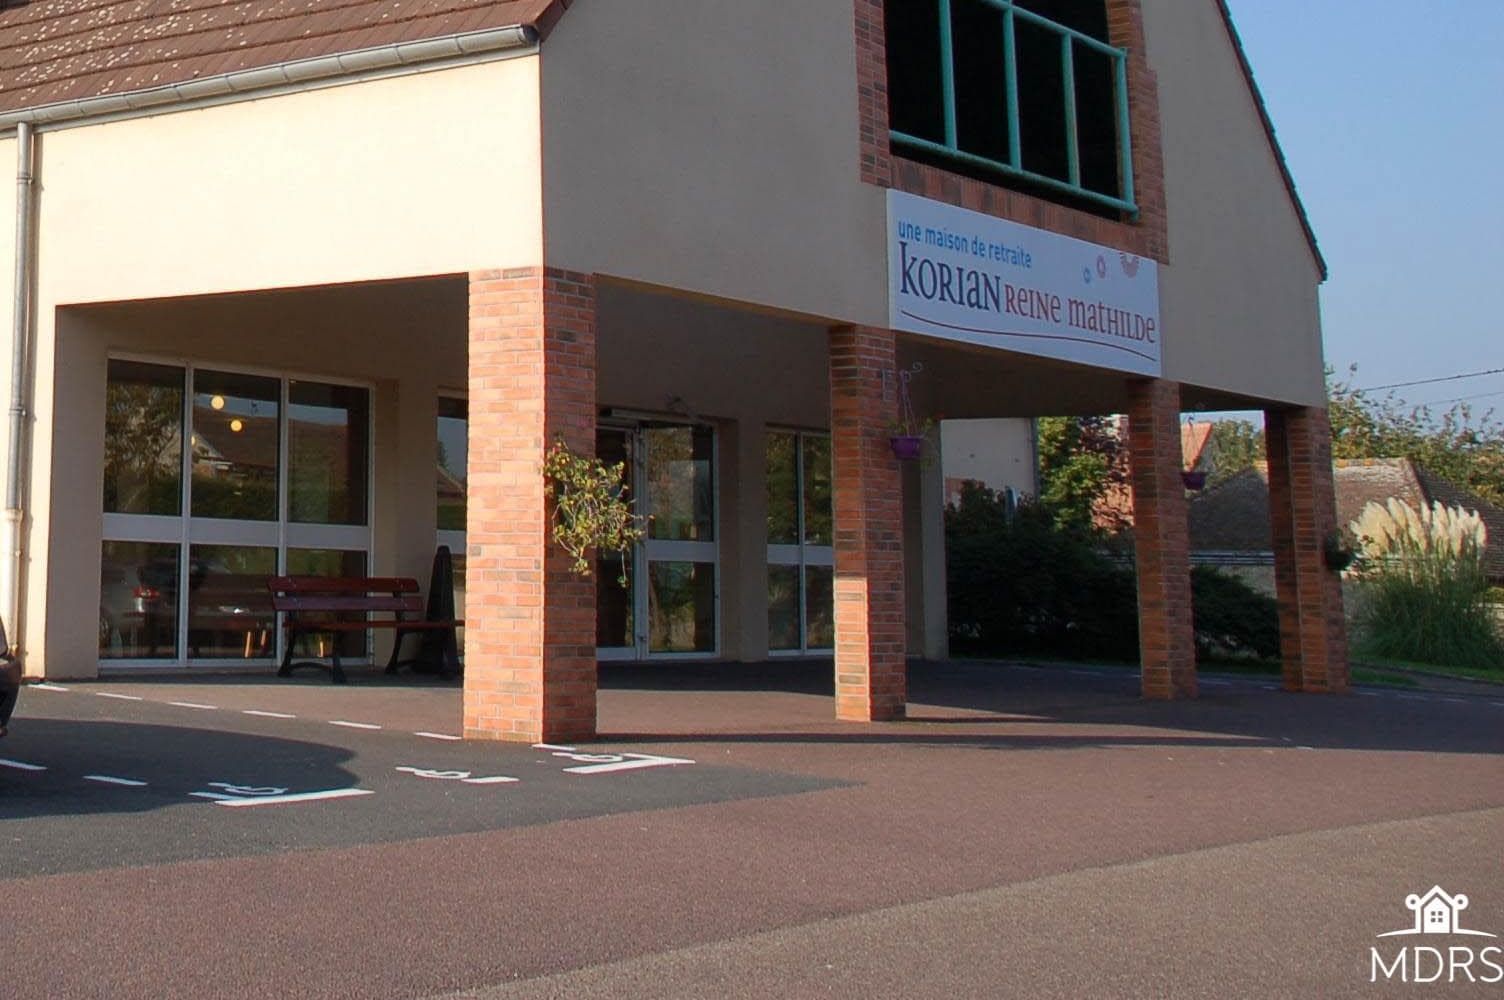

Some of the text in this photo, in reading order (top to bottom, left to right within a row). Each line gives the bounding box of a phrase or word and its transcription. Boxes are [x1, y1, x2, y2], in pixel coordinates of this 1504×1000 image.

[898, 221, 1032, 268] une maison de retraite
